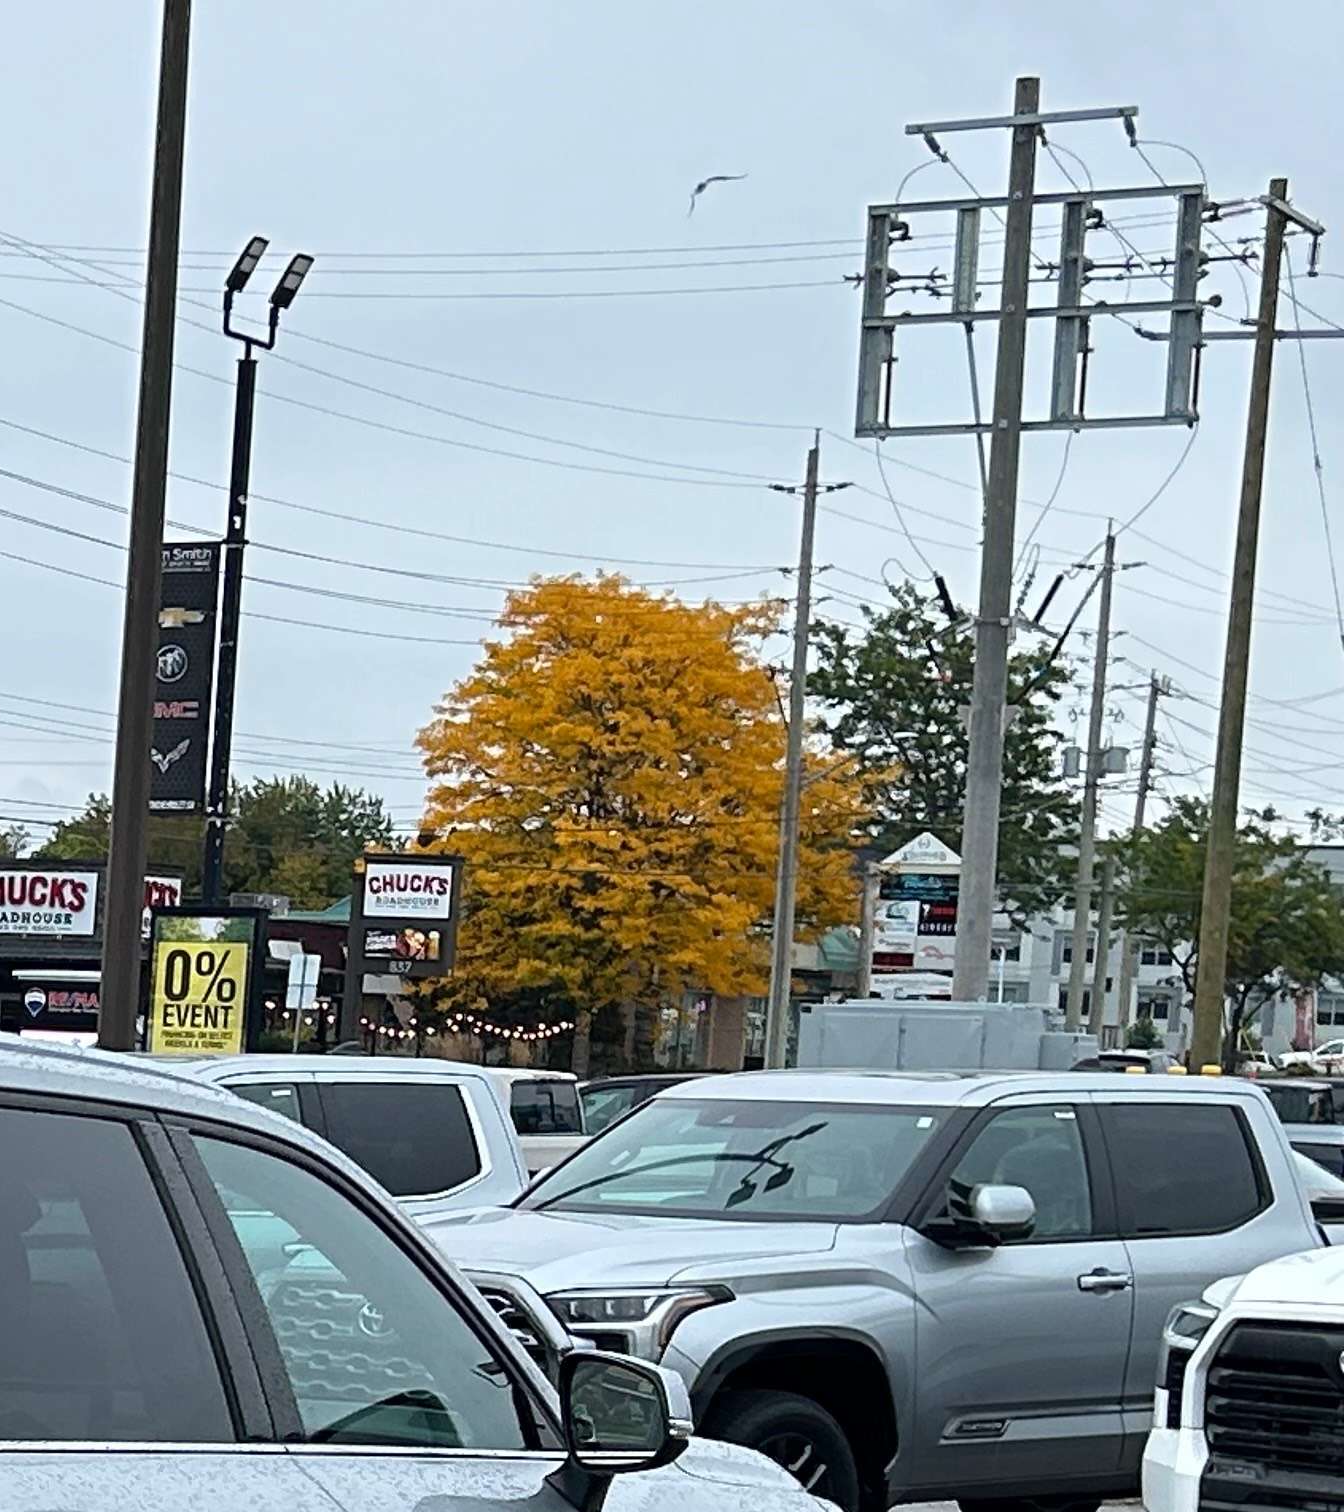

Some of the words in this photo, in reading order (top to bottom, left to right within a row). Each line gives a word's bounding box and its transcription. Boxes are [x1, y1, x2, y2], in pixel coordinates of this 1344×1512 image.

[153, 701, 199, 718] MC
[369, 873, 449, 896] CHUCK'S
[164, 949, 236, 1003] 0%
[48, 991, 100, 1008] RE/MA
[162, 1003, 234, 1029] EVENT
